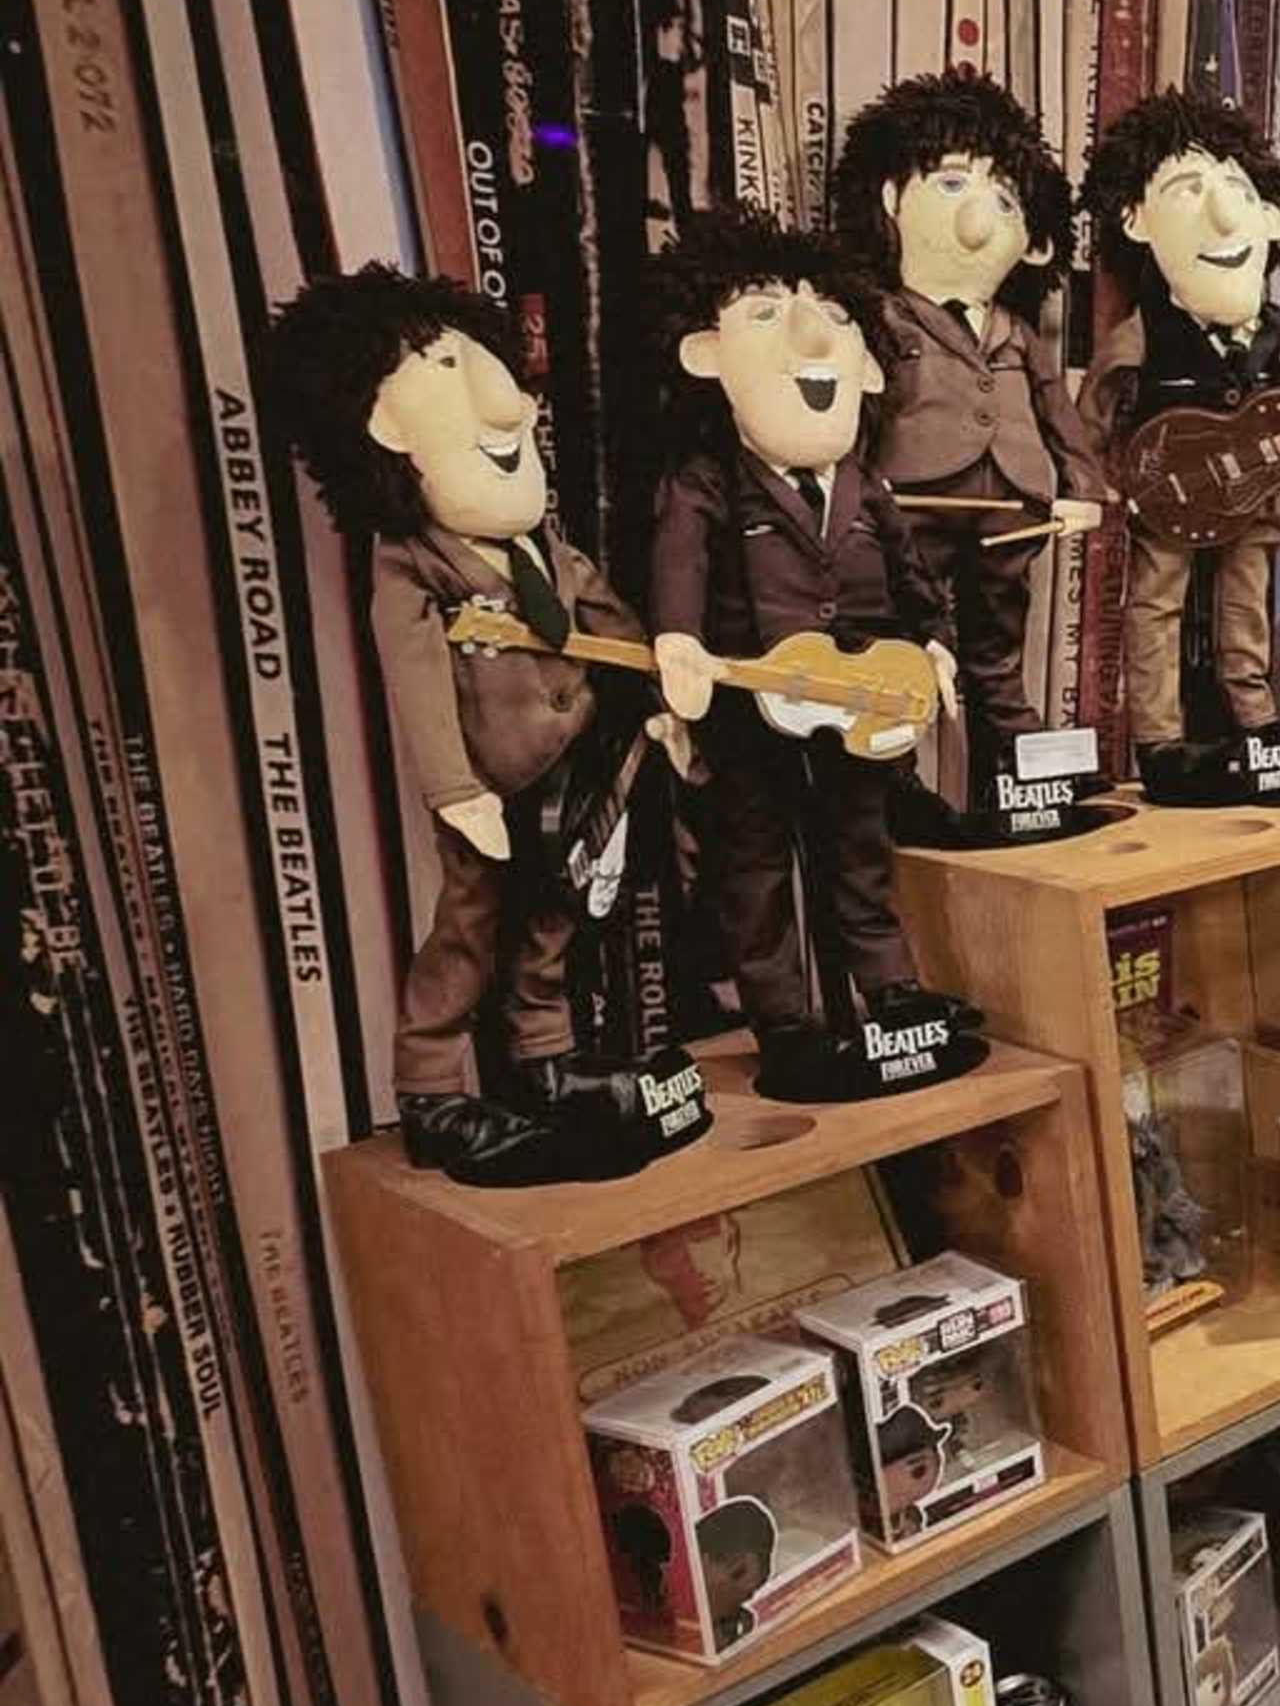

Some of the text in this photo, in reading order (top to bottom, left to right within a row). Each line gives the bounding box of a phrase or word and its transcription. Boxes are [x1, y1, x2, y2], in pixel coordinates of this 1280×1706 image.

[467, 141, 497, 213] OUT
[738, 118, 762, 217] KINKS
[477, 217, 503, 266] OF
[216, 387, 282, 682] ABBEY ROAD
[998, 773, 1074, 810] BEATLES
[261, 733, 323, 985] THE BEATLES
[636, 884, 669, 1057] THE ROLLI
[122, 993, 152, 1058] THE
[864, 1019, 949, 1060] BEATLES
[639, 1063, 702, 1117] BEATLES
[135, 1061, 174, 1196] BEATLES
[186, 1342, 222, 1421] SOUL
